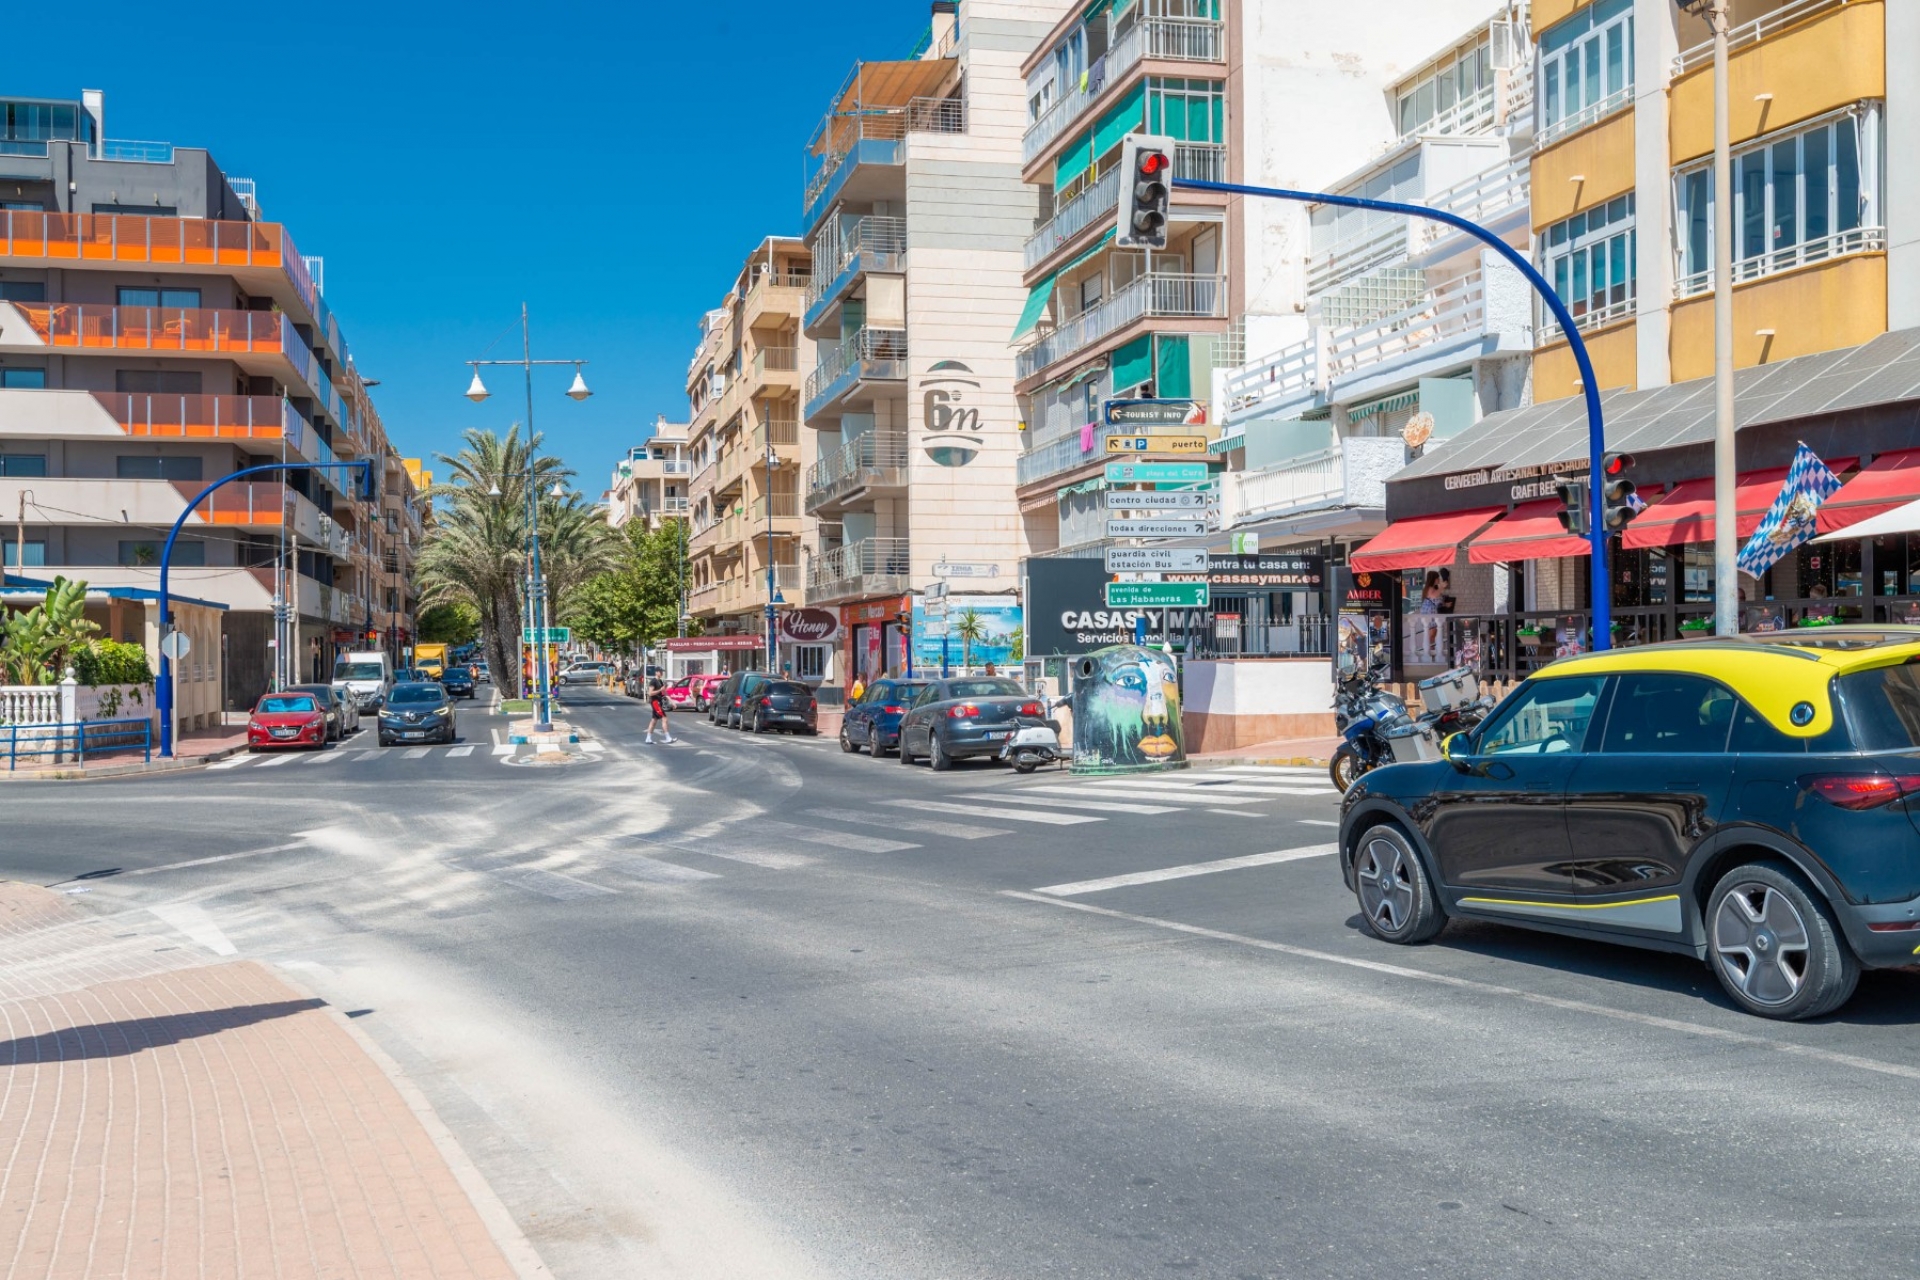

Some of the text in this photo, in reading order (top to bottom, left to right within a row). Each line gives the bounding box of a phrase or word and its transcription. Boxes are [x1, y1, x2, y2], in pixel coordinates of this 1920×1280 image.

[1171, 441, 1204, 449] puerto
[1540, 464, 1548, 476] Y
[1511, 483, 1538, 500] CRAFT
[1110, 496, 1177, 504] centro ciudad
[1208, 560, 1311, 570] entra tu casa en:
[1166, 574, 1320, 586] www.casasymar.es
[1131, 595, 1181, 603] Habaneras
[1346, 589, 1383, 600] AMBER
[789, 610, 830, 639] Honey
[1061, 610, 1138, 630] CASAS
[1145, 611, 1163, 629] Y
[1076, 632, 1130, 644] Servicios
